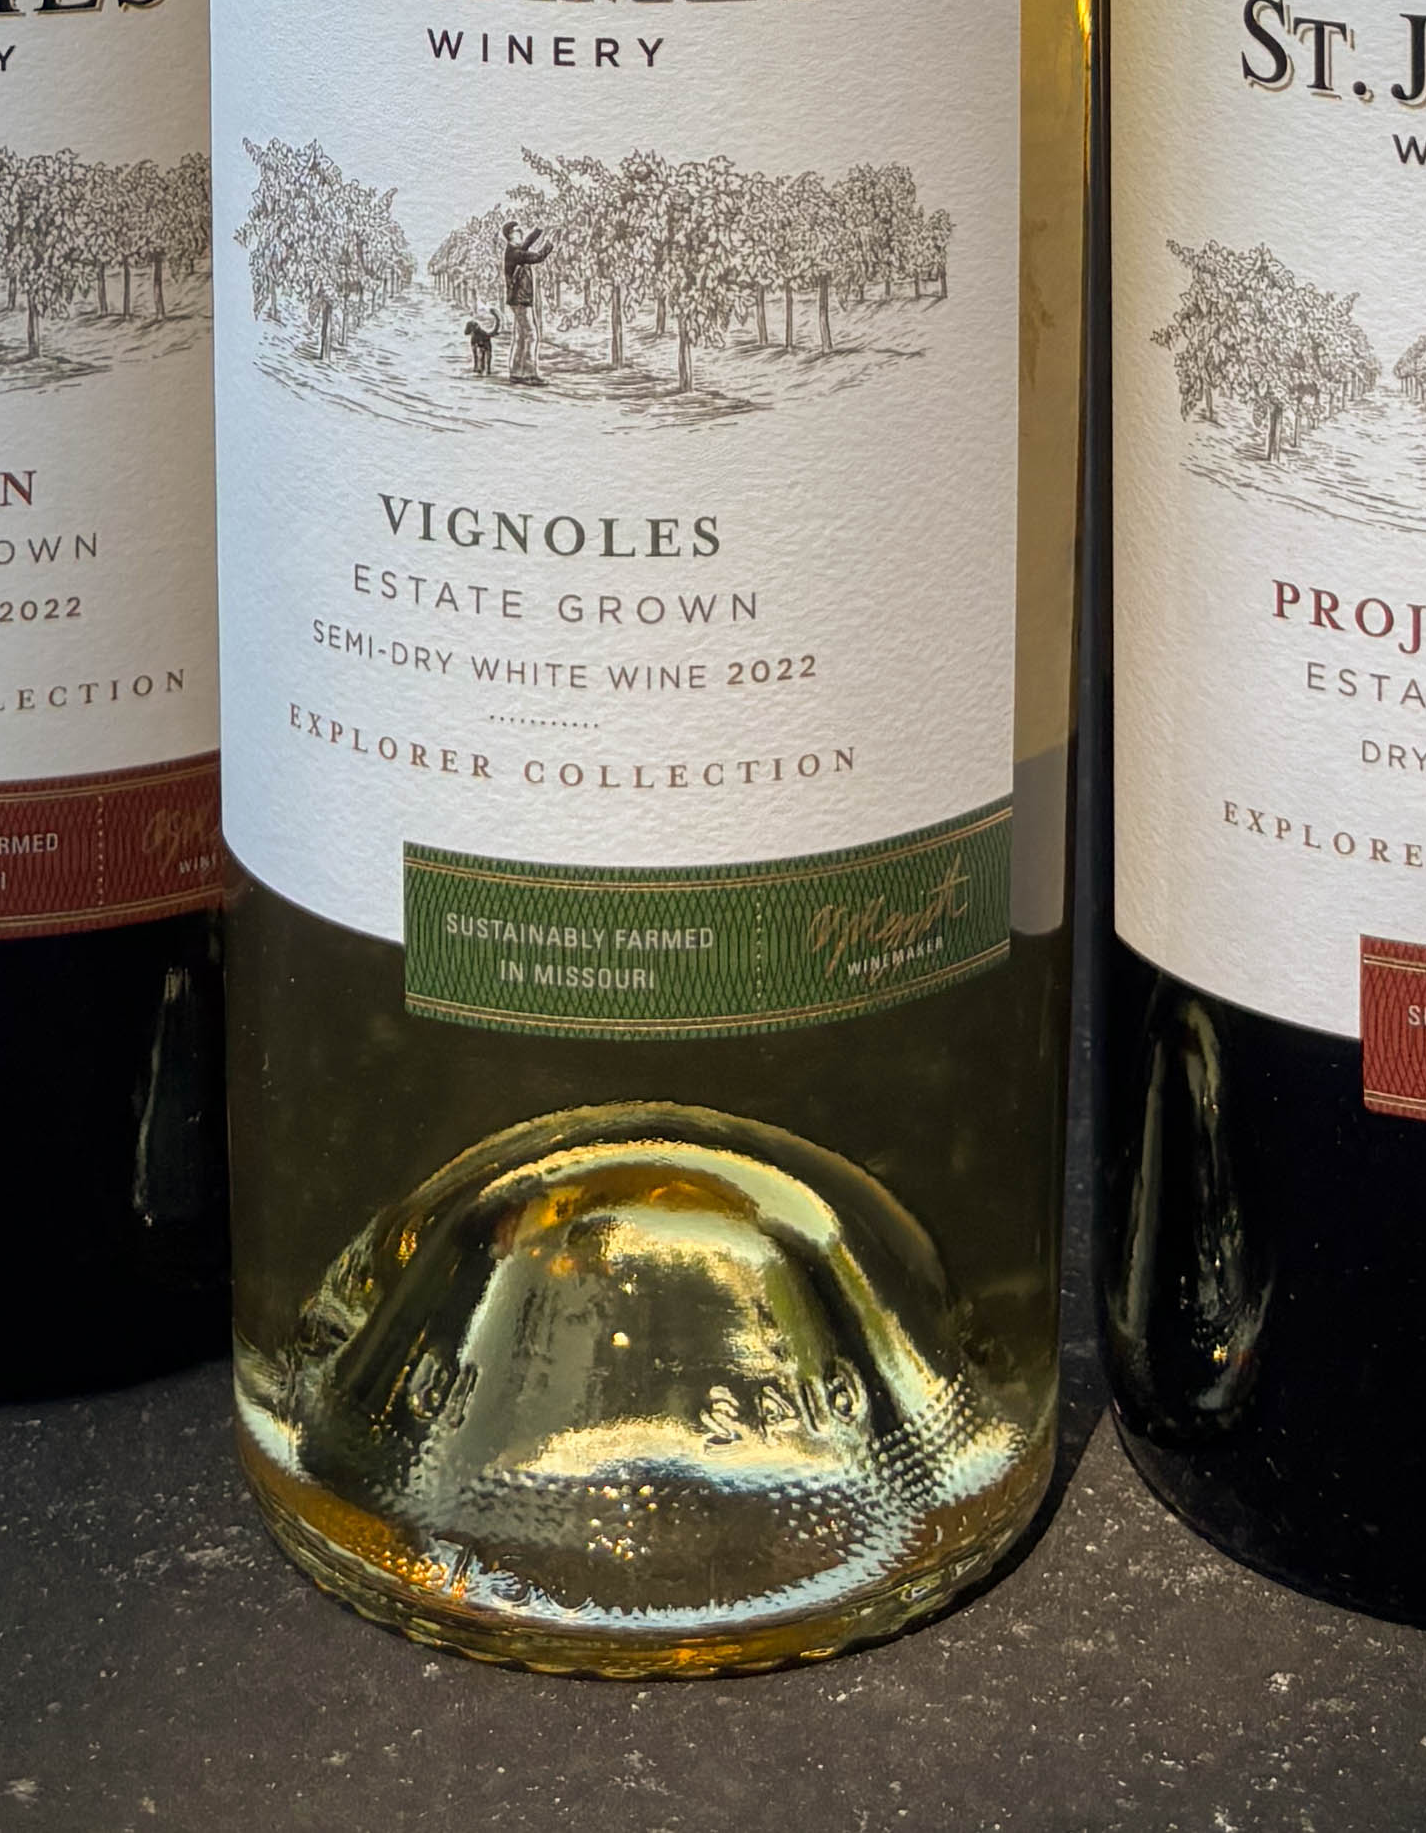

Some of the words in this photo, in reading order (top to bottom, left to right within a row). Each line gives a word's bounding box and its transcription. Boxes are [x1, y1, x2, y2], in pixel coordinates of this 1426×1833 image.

[428, 28, 664, 67] WINERY
[377, 493, 721, 559] VIGNOLES
[354, 564, 524, 619] ESTATE
[559, 591, 759, 625] GROWN
[312, 618, 453, 675] SEMI-DRY
[471, 655, 588, 690] WHITE
[608, 664, 706, 690] WINE
[727, 655, 817, 687] 2022
[289, 702, 493, 780] EXPLORER
[524, 746, 858, 791] COLLECTION
[446, 912, 606, 952] SUSTAINABLY
[614, 927, 715, 951] FARMED
[847, 936, 943, 976] WINEMAKER
[499, 962, 524, 985] IN
[534, 965, 655, 991] MISSOURI
